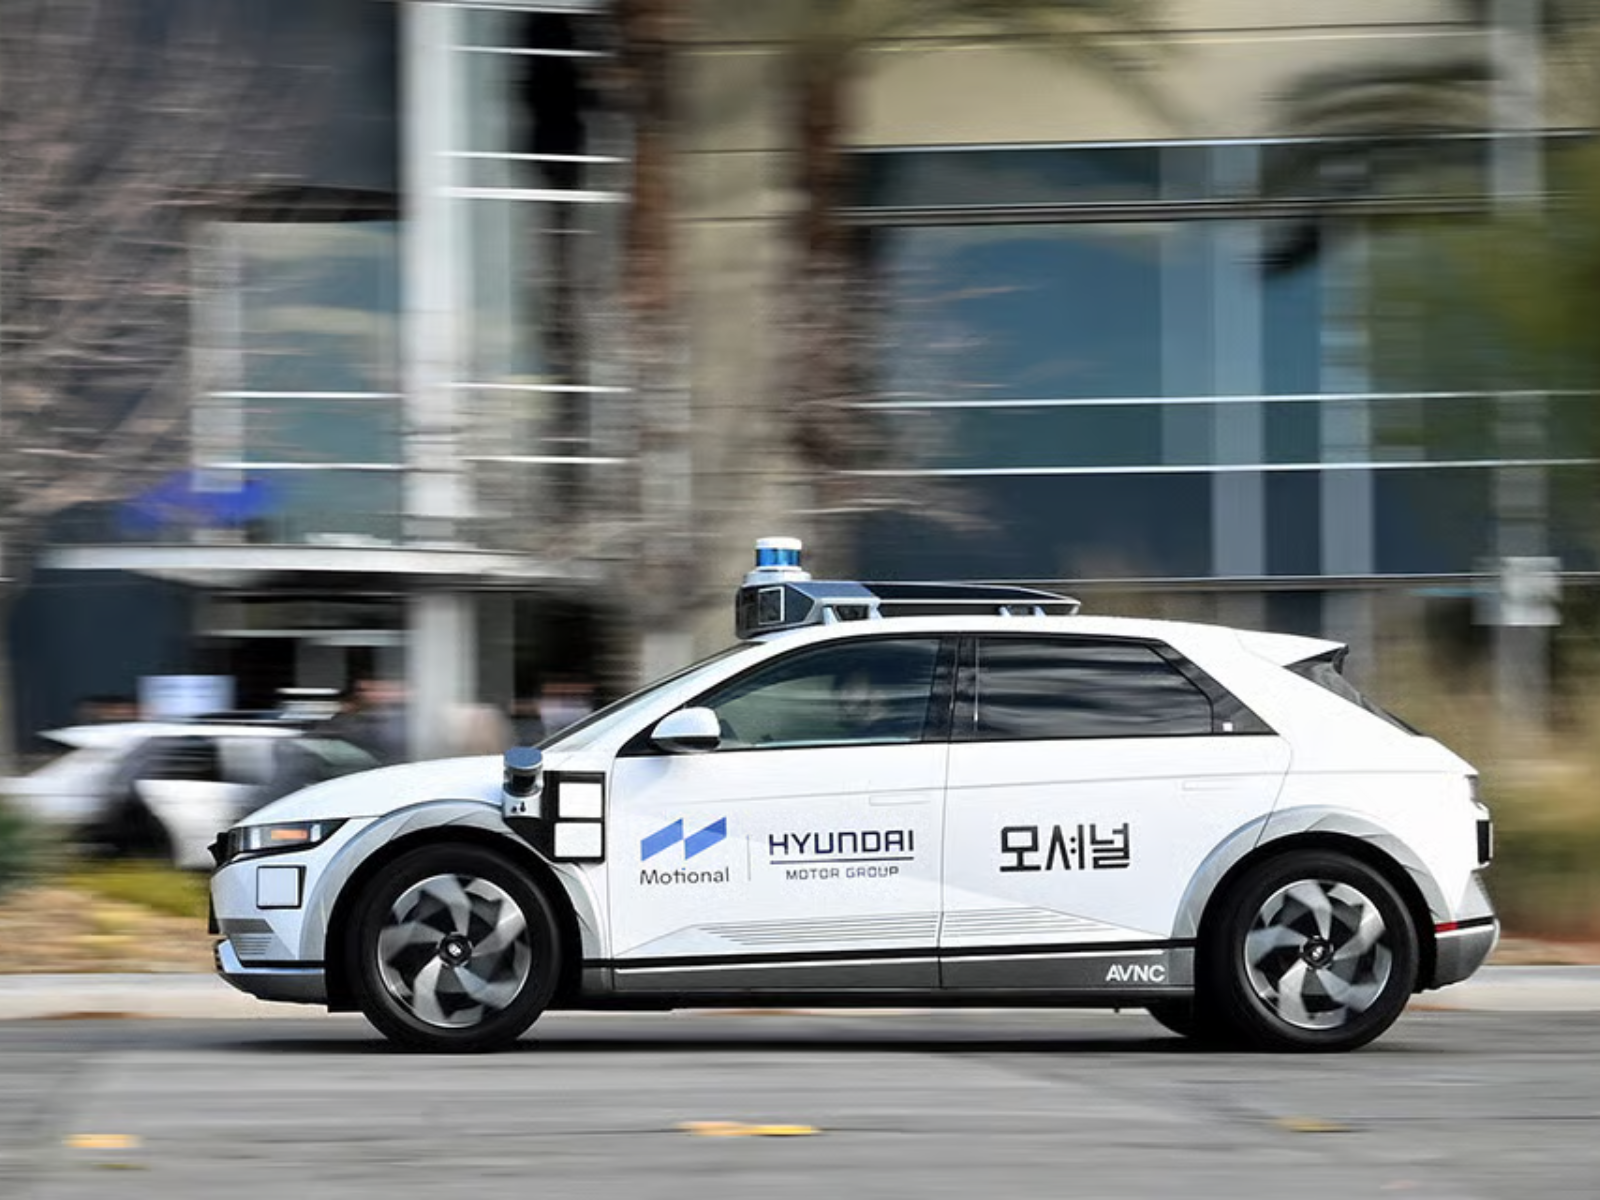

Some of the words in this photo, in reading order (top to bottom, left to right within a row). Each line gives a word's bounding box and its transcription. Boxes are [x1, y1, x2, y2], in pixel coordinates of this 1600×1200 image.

[768, 830, 914, 855] HYUNDAI
[1000, 823, 1130, 872] 모셔널
[639, 867, 729, 885] Motional
[785, 867, 840, 881] MOTOR
[846, 866, 899, 880] GROUP
[1105, 964, 1165, 982] AVNC
